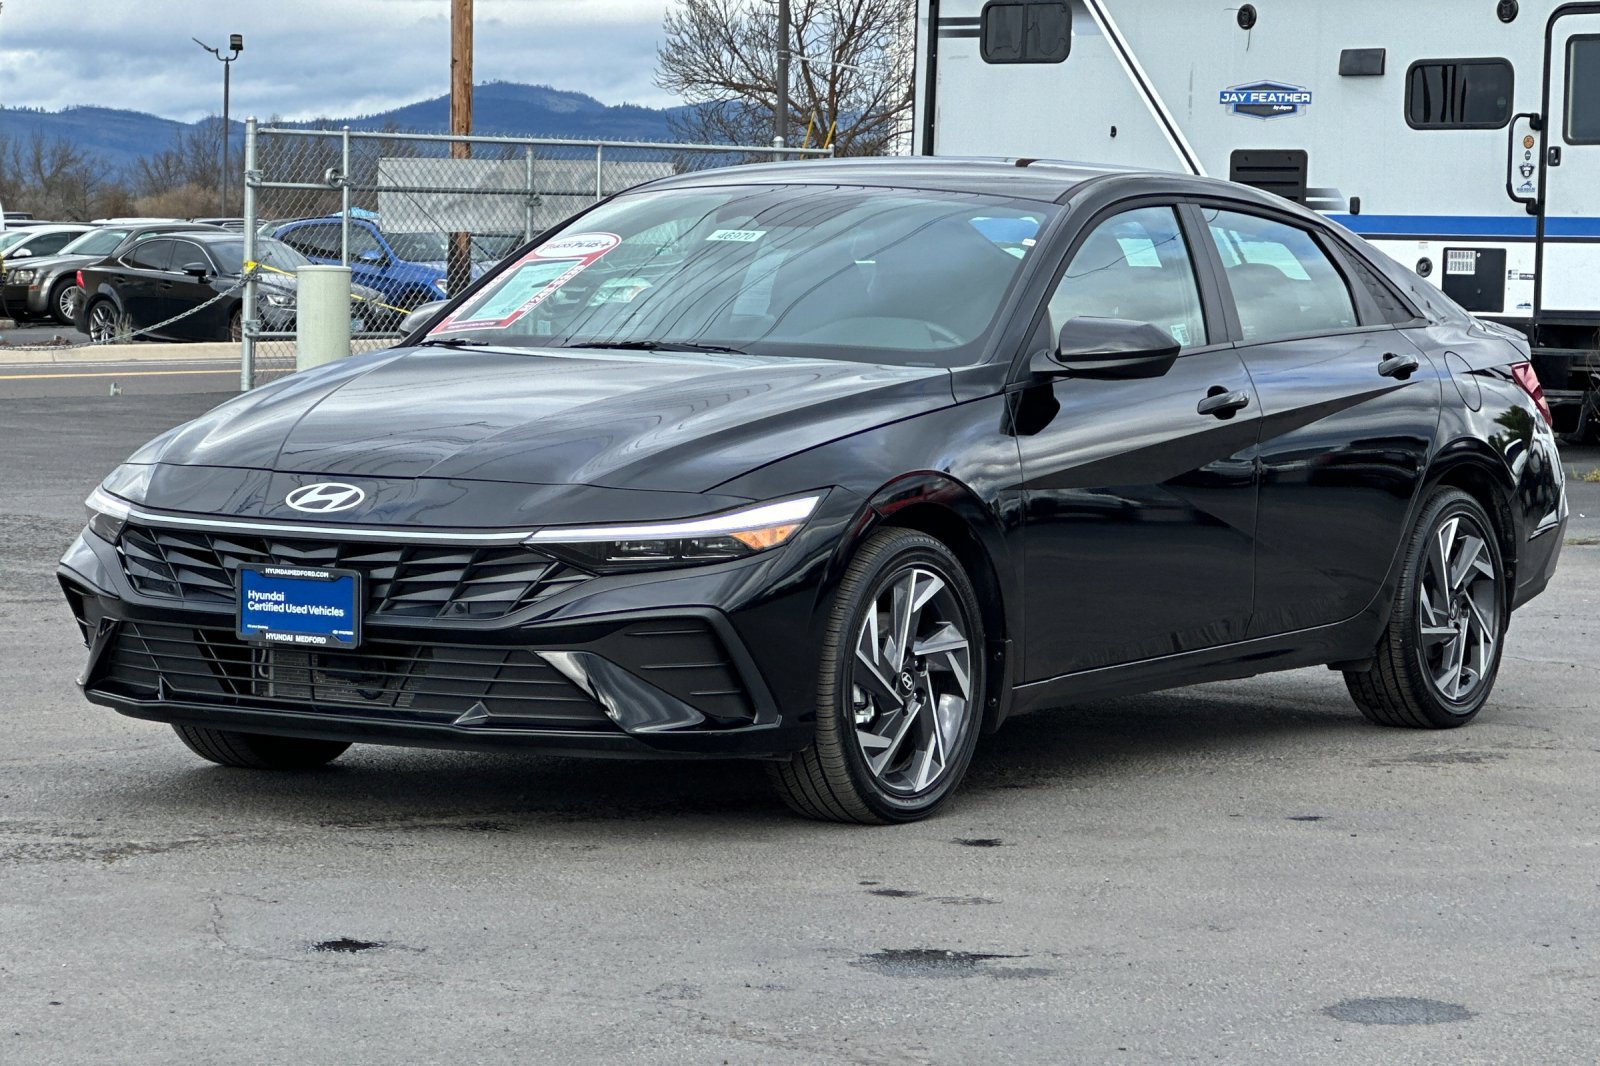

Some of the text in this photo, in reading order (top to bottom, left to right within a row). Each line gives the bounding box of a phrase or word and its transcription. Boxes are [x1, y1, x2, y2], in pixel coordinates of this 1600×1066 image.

[1221, 93, 1310, 102] JAY FEATHER
[717, 232, 756, 240] 46970
[265, 568, 329, 578] HYUNDAIMEDFORD.COM
[247, 590, 285, 602] Hyundai
[247, 602, 344, 617] Certified Used Vehicles
[265, 632, 327, 645] HYUNDAI MEDFORD
